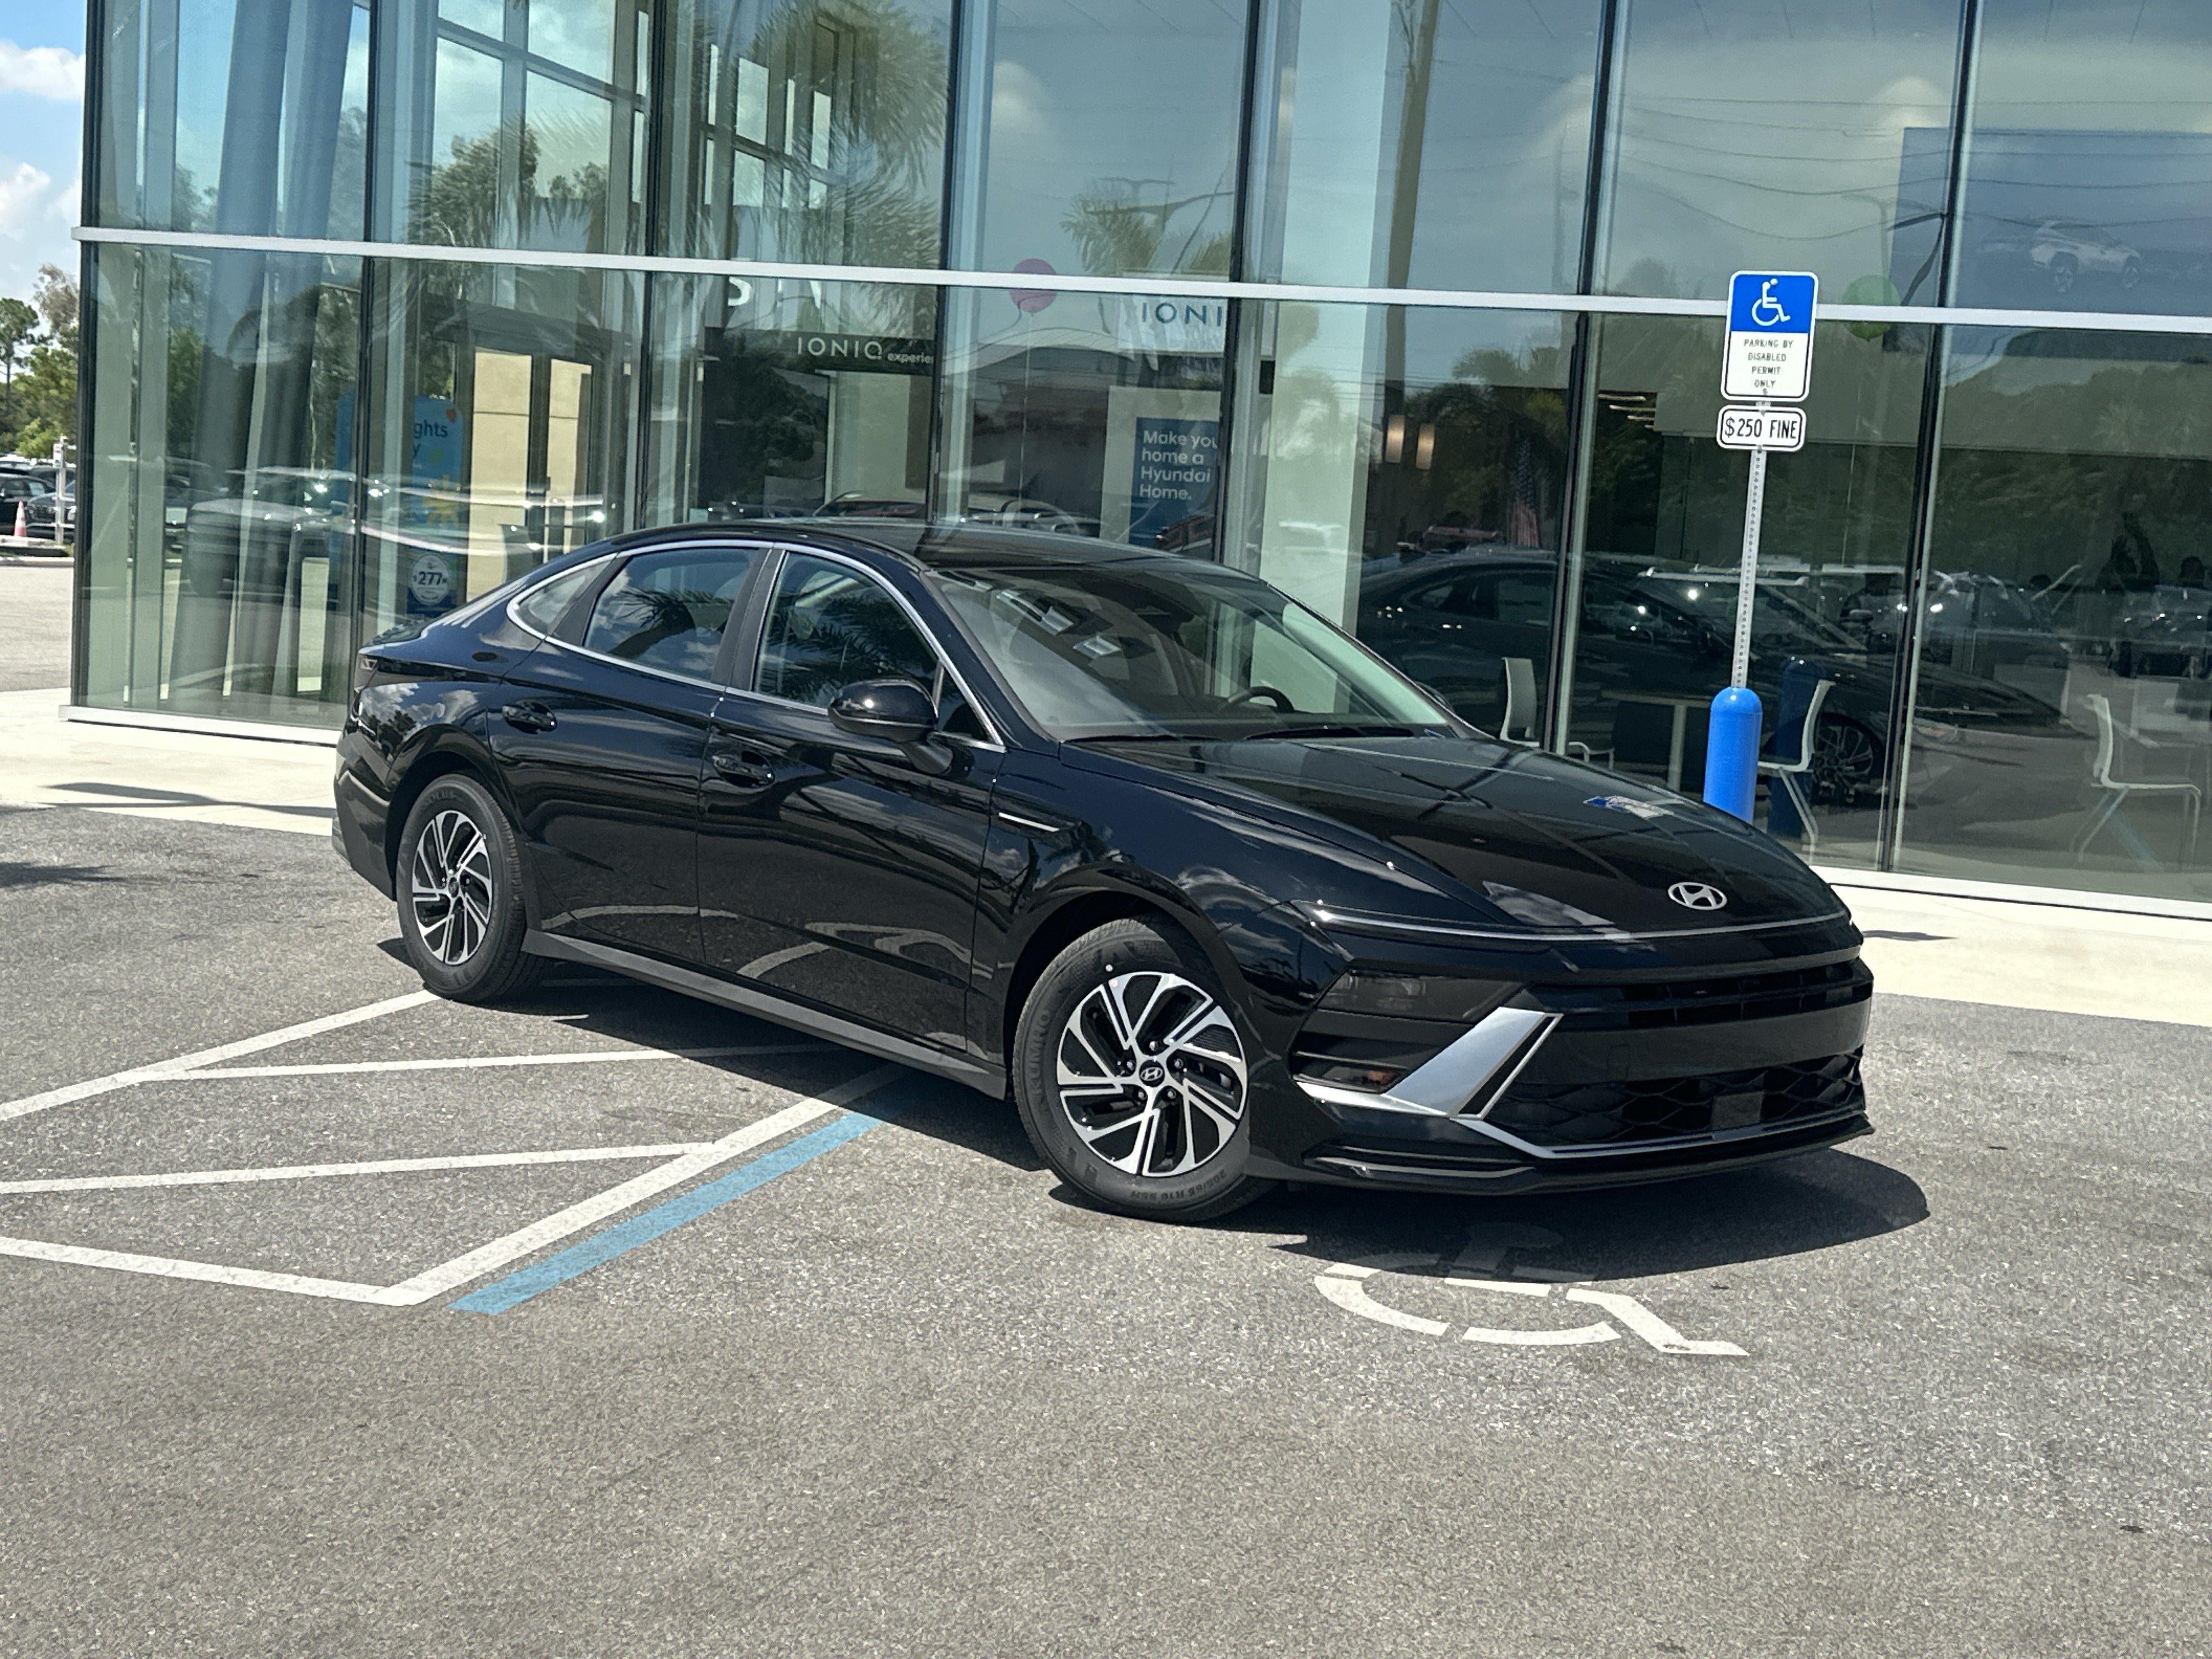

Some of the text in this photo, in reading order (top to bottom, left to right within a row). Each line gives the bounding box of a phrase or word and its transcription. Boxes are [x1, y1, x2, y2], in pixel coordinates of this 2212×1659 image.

[798, 336, 882, 360] IONIQ
[1743, 338, 1793, 348] PARKING BY
[1748, 352, 1786, 362] DISABLED
[1752, 366, 1781, 375] PERMIT
[1754, 379, 1776, 388] ONLY
[1725, 416, 1798, 439] $250 FINE
[1143, 430, 1187, 445] Make
[1141, 447, 1204, 465] home a
[1141, 465, 1211, 483] Hyundai
[1139, 483, 1192, 500] Home.
